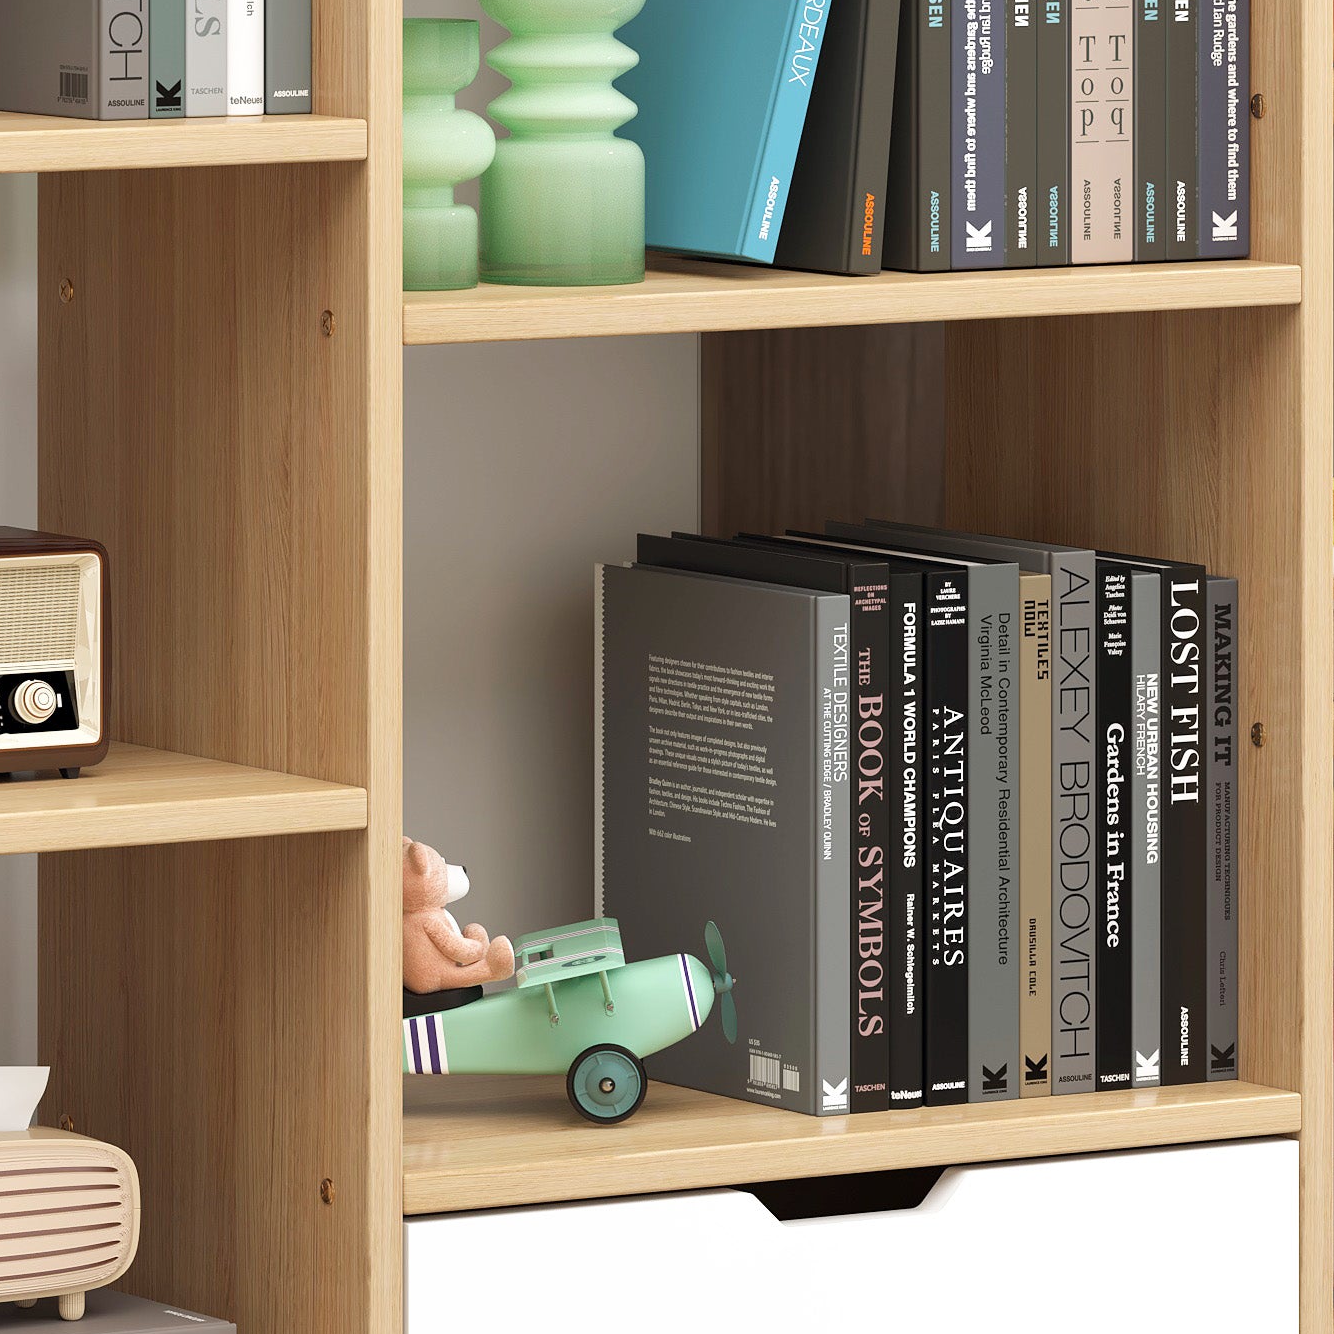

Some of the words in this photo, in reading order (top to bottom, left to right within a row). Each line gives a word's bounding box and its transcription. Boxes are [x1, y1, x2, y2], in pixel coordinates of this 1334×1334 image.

[1210, 29, 1225, 67] Rudge
[1213, 8, 1225, 27] Ian
[1225, 13, 1240, 63] gardens
[107, 98, 145, 108] ASSOULINE
[191, 87, 224, 95] TASCHEN
[273, 89, 309, 98] ASSOULINE
[1227, 65, 1240, 87] and
[1227, 88, 1240, 127] where
[1227, 128, 1239, 142] to
[1227, 143, 1240, 168] find
[1227, 169, 1240, 201] them
[758, 176, 780, 241] ASSOULINE
[862, 192, 875, 255] ASSOULINE
[930, 190, 940, 253] ASSOULINE
[1083, 179, 1092, 241] ASSOULINE
[1146, 182, 1155, 243] ASSOULINE
[1176, 180, 1186, 242] ASSOULINE
[833, 623, 848, 688] TEXTILE
[903, 602, 916, 685] FORMULA
[978, 614, 993, 671] Virginia
[998, 613, 1011, 657] Detail
[1037, 599, 1049, 680] TEXTILES
[1060, 567, 1090, 743] ALEXEY
[1170, 579, 1200, 694] LOST
[1214, 603, 1232, 727] MAKING
[858, 648, 871, 686] THE
[998, 660, 1011, 673] in
[1136, 674, 1146, 719] HILARY
[1146, 673, 1158, 713] NEW
[903, 700, 916, 764] WORLD
[980, 676, 993, 735] McLeod
[996, 675, 1011, 784] Contemporary
[833, 691, 848, 783] DESIGNERS
[858, 693, 884, 805] BOOK
[1136, 723, 1146, 776] FRENCH
[1146, 717, 1158, 780] URBAN
[1170, 703, 1200, 805] FISH
[1214, 735, 1232, 767] IT
[1106, 722, 1125, 825] Gardens
[858, 813, 871, 836] OF
[903, 769, 916, 868] CHAMPIONS
[939, 706, 965, 966] ANTIQUAIRES
[998, 789, 1011, 871] Residential
[1106, 832, 1125, 857] in
[1146, 783, 1159, 864] HOUSING
[998, 875, 1011, 965] Architecture
[1059, 761, 1090, 1058] BRODOVITCH
[1106, 862, 1125, 948] France
[858, 846, 884, 1037] SYMBOLS
